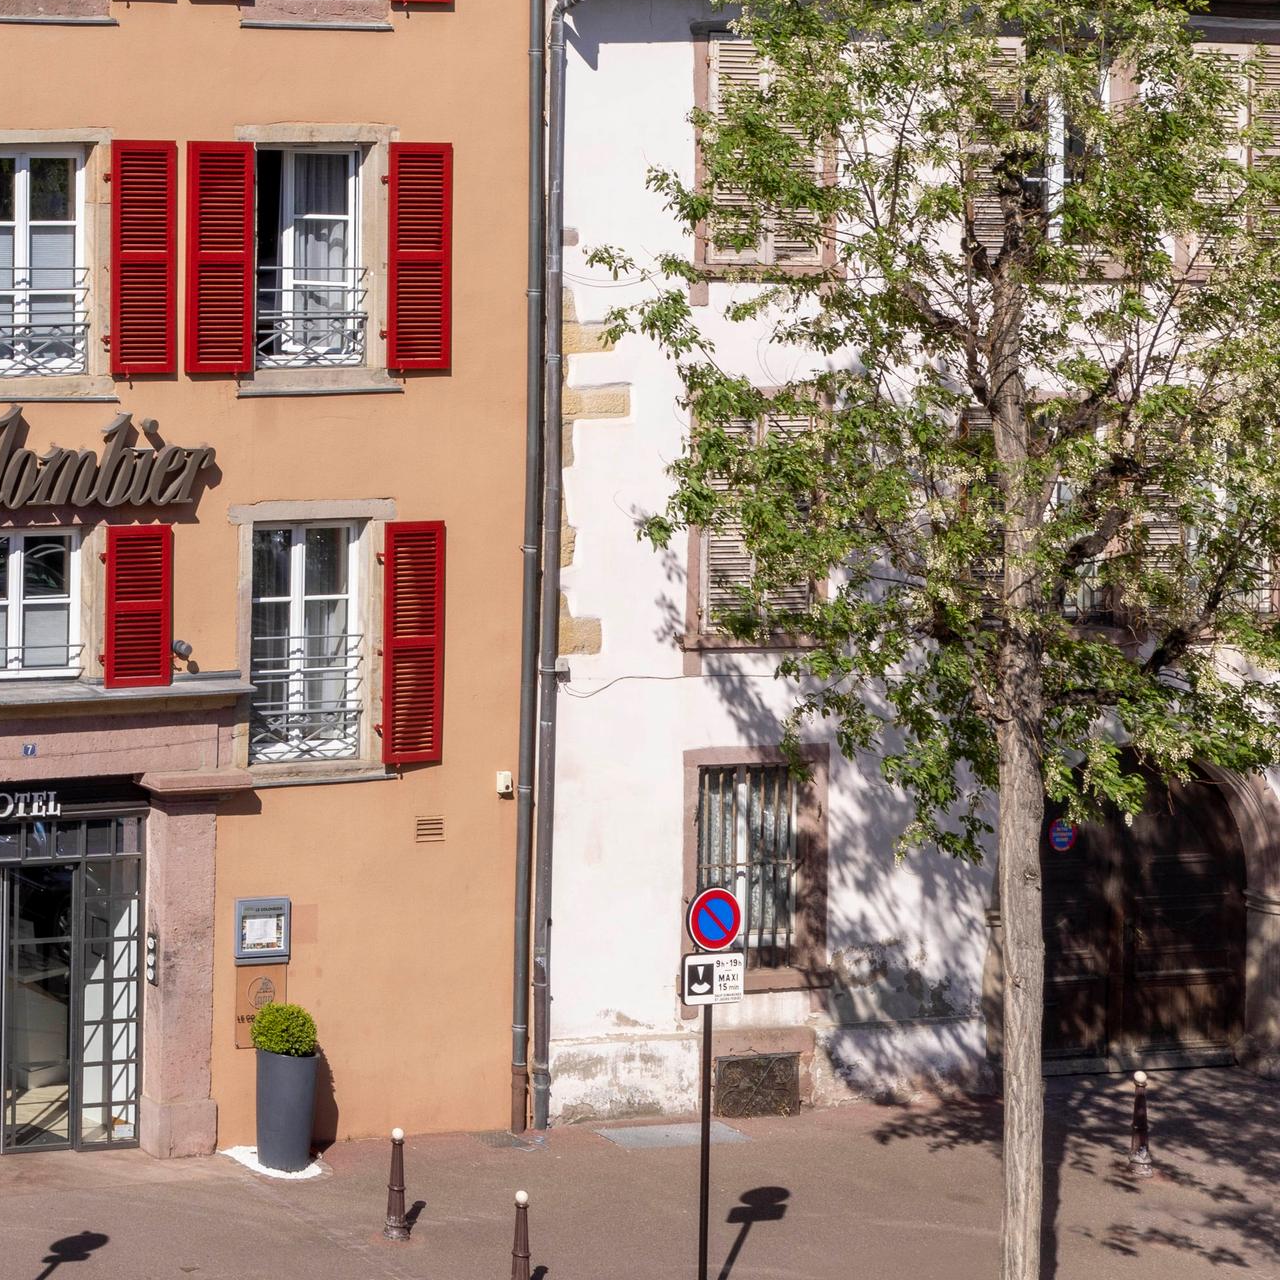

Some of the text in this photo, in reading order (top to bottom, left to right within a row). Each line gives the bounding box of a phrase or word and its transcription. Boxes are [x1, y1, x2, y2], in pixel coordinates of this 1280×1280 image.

[27, 745, 33, 755] 7
[718, 973, 739, 982] MAXI
[719, 983, 728, 991] 15
